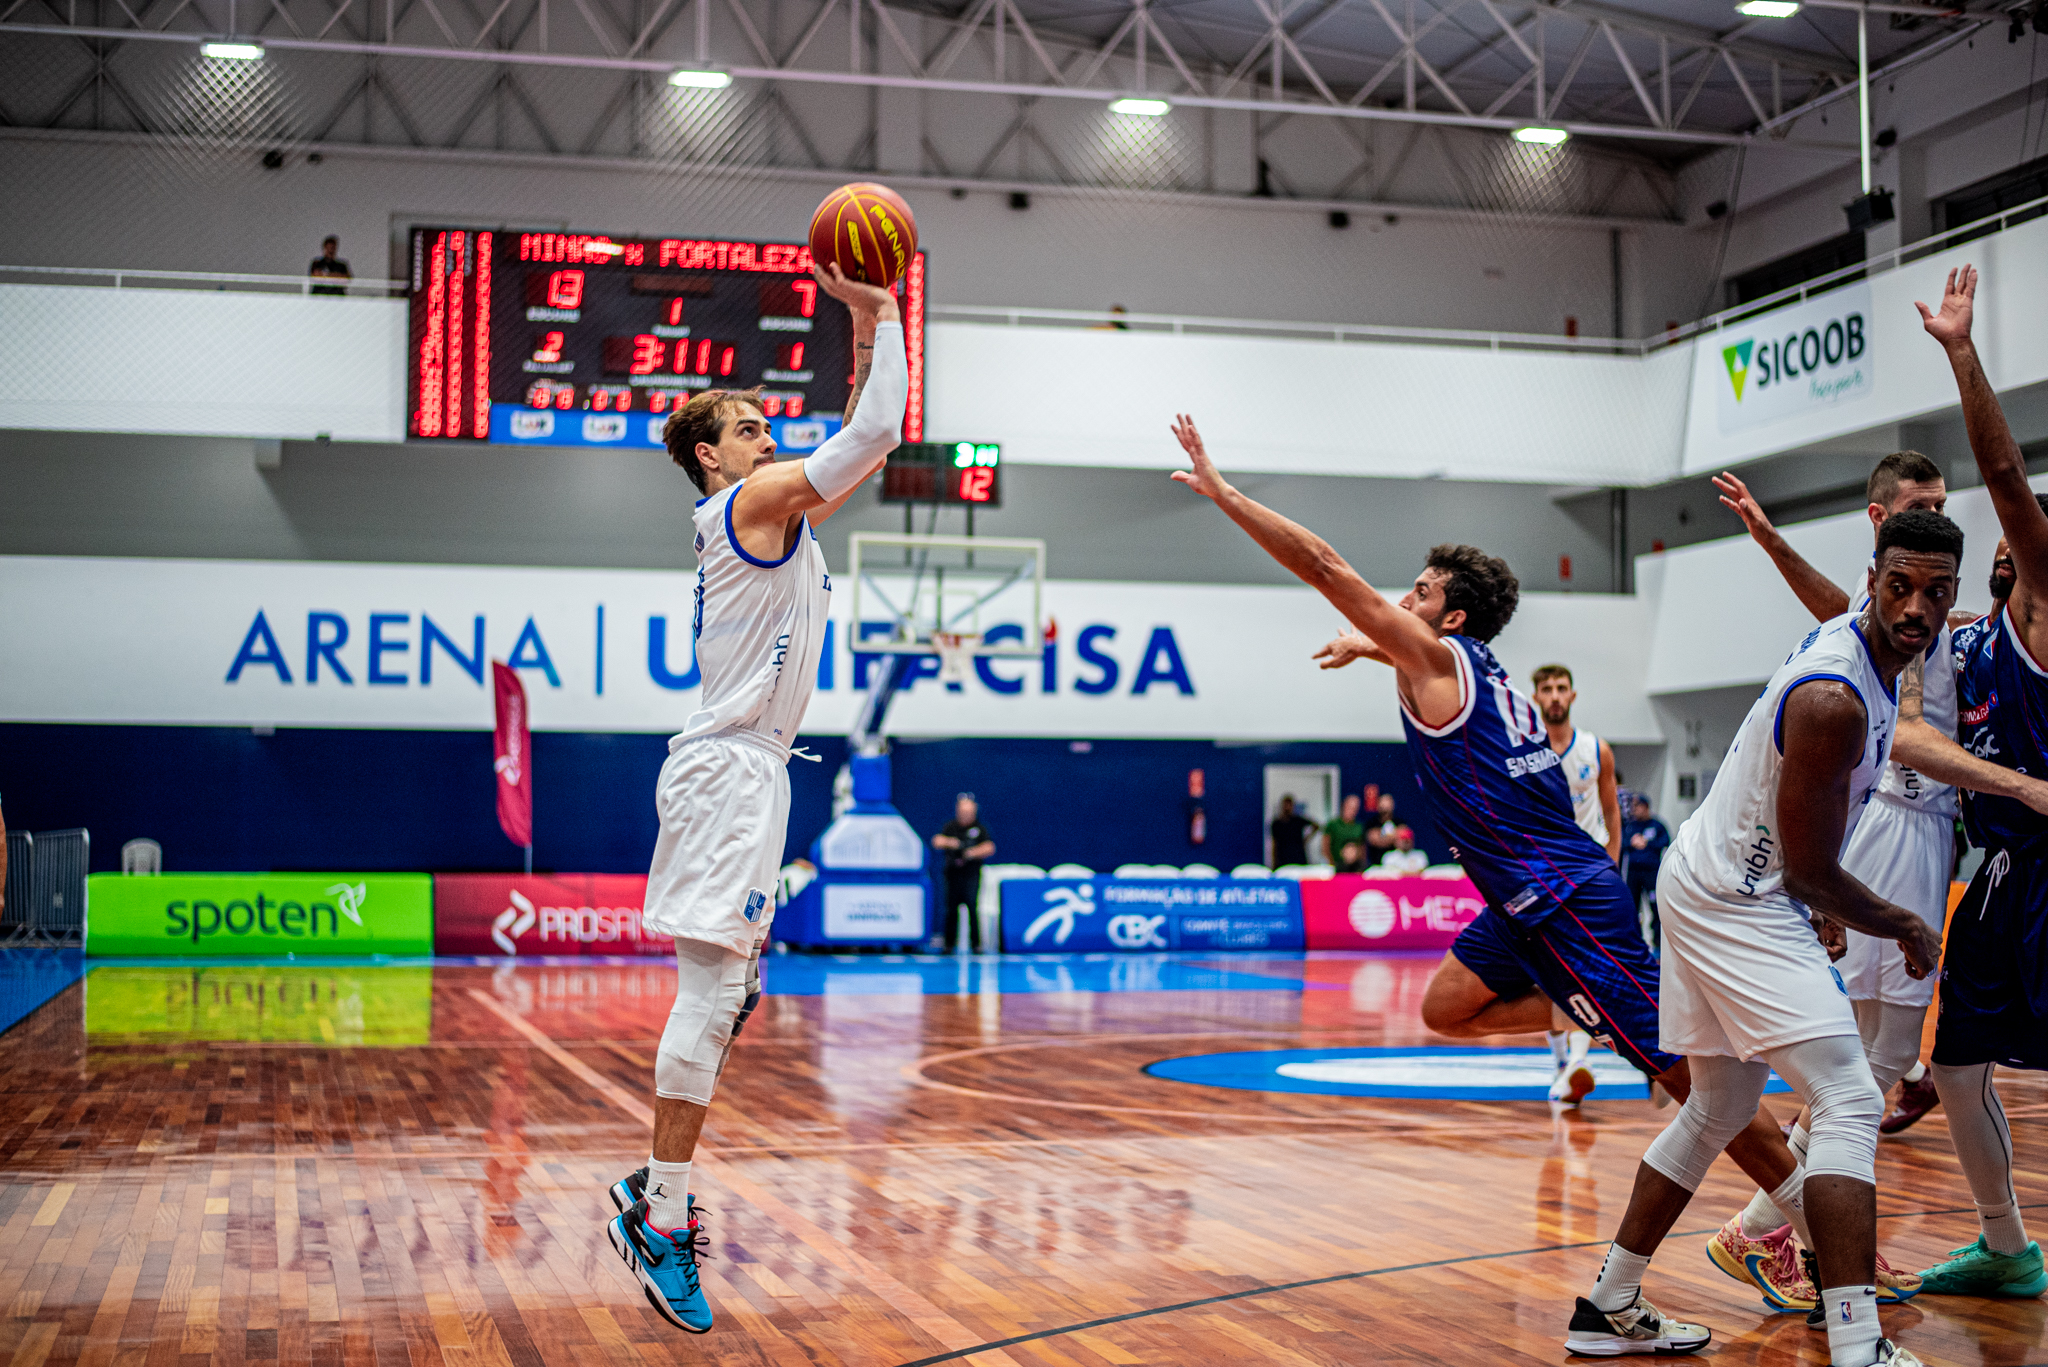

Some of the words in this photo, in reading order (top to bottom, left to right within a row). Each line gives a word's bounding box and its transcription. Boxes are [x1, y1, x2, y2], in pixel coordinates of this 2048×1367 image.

[659, 239, 815, 274] FORTALEZA
[547, 269, 585, 309] 13
[791, 279, 817, 318] 7
[1757, 313, 1865, 386] SICOOB
[959, 465, 995, 502] 12
[225, 608, 562, 688] ARENA
[1736, 837, 1775, 896] unibh
[166, 893, 340, 944] spoten
